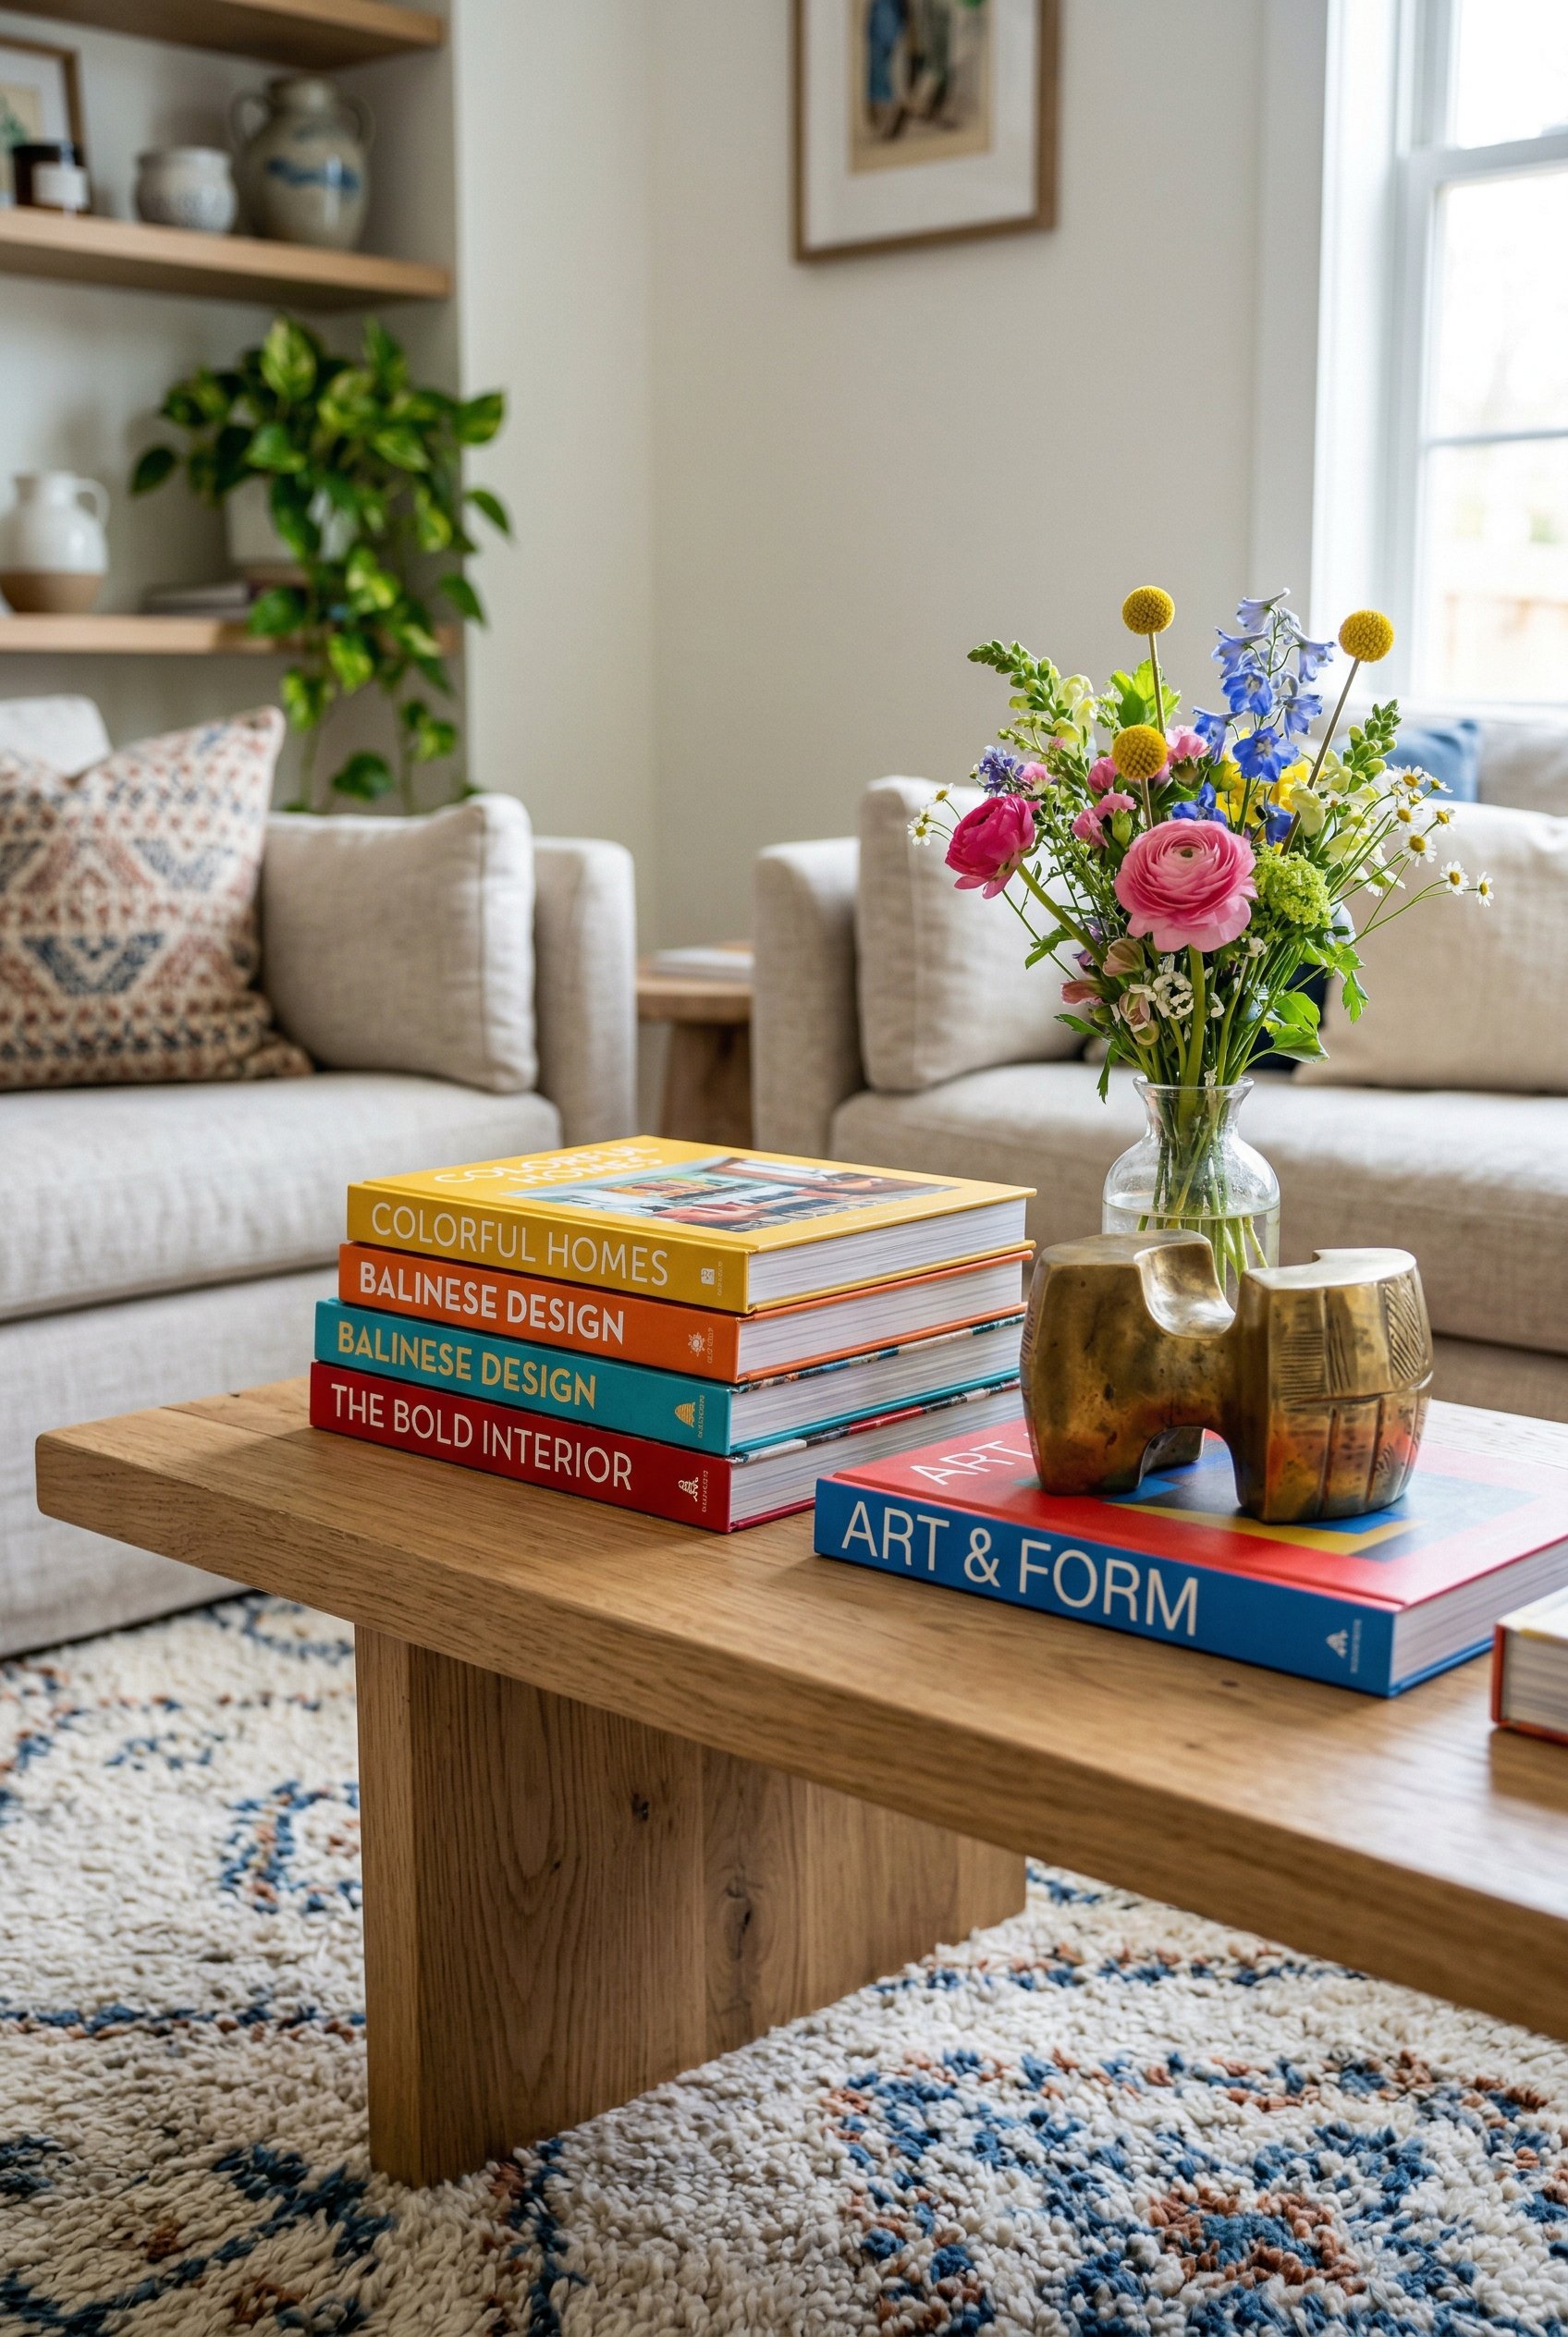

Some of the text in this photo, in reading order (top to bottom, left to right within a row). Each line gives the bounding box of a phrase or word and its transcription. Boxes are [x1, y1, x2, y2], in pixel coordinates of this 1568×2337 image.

[372, 1203, 536, 1263] COLORFUL
[547, 1231, 668, 1287] HOMES
[360, 1261, 625, 1343] BALINESE DESIGN
[338, 1322, 596, 1409] BALINESE DESIGN
[331, 1384, 632, 1491] THE BOLD INTERIOR
[910, 1440, 1034, 1486] ART
[842, 1501, 1198, 1636] ART & FORM
